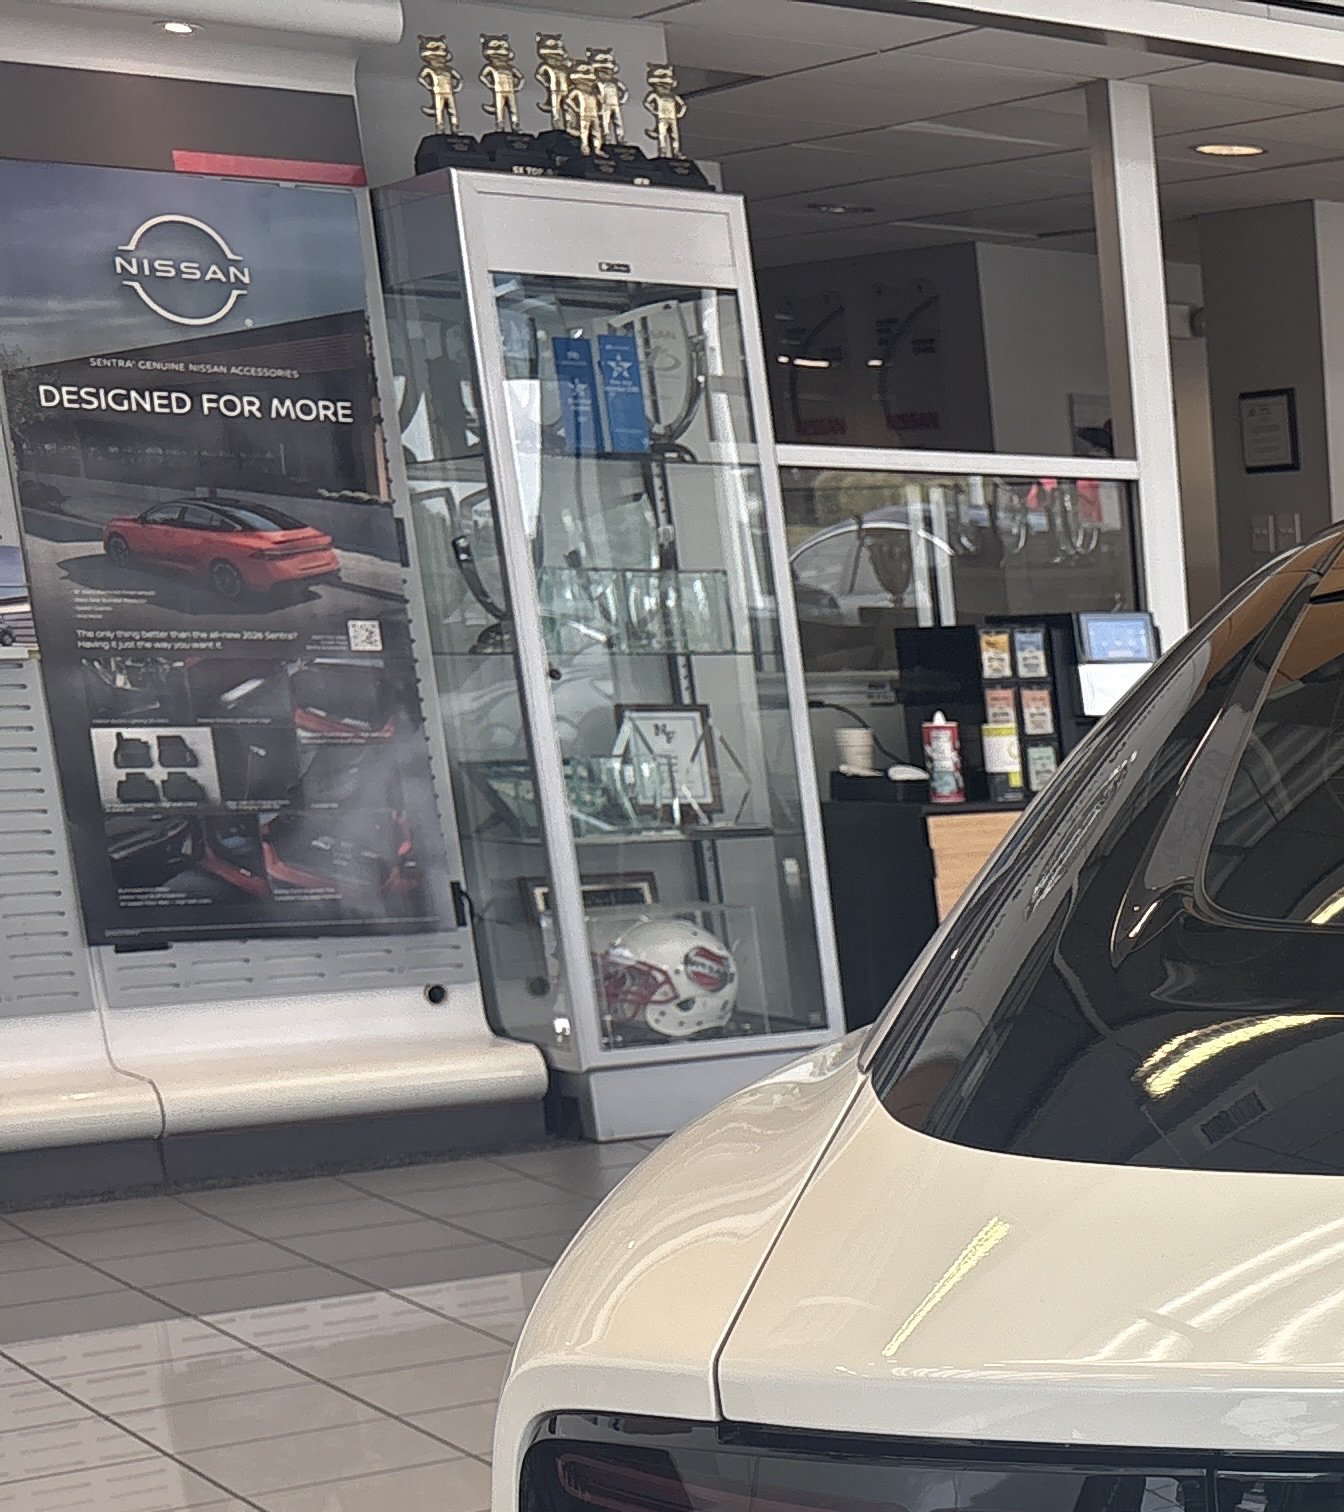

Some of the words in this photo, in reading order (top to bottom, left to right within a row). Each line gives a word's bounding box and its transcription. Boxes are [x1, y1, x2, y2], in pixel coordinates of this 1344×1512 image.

[114, 255, 251, 284] NISSAN
[138, 360, 185, 372] GENUINE
[189, 363, 227, 374] NISSAN
[230, 366, 299, 379] ACCESSORIES
[38, 384, 192, 414] DESIGNED
[202, 393, 262, 418] FOR
[270, 397, 354, 424] MORE
[76, 630, 95, 639] The
[95, 631, 115, 640] only
[115, 630, 141, 640] thing
[141, 630, 168, 639] better
[77, 641, 111, 651] Having
